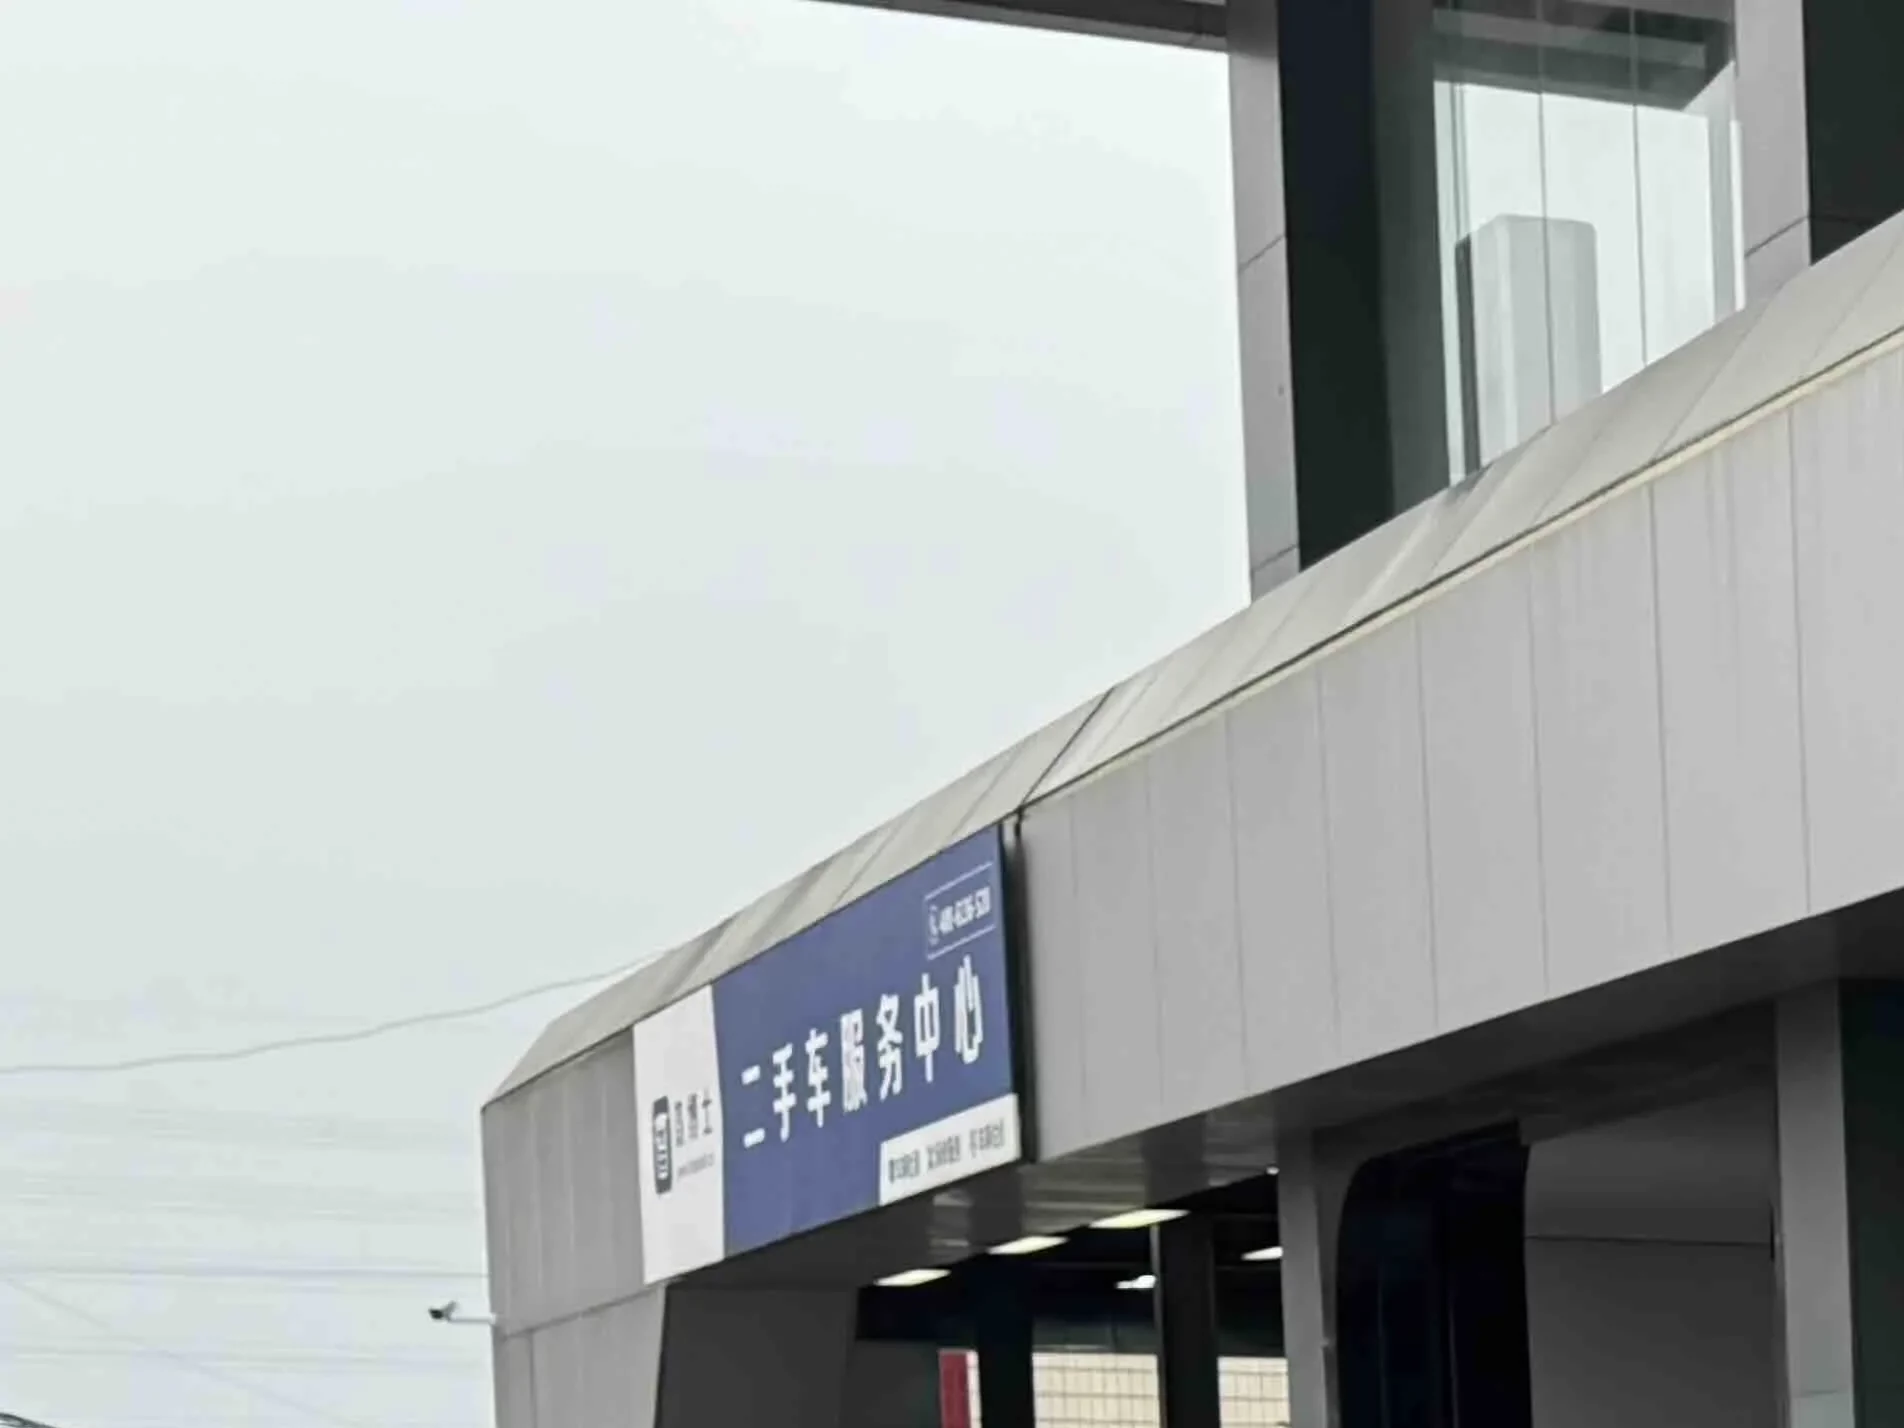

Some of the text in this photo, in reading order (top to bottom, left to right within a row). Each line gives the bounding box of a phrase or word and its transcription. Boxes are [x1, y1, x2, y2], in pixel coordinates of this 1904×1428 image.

[740, 953, 984, 1149] 二手车服务中心
